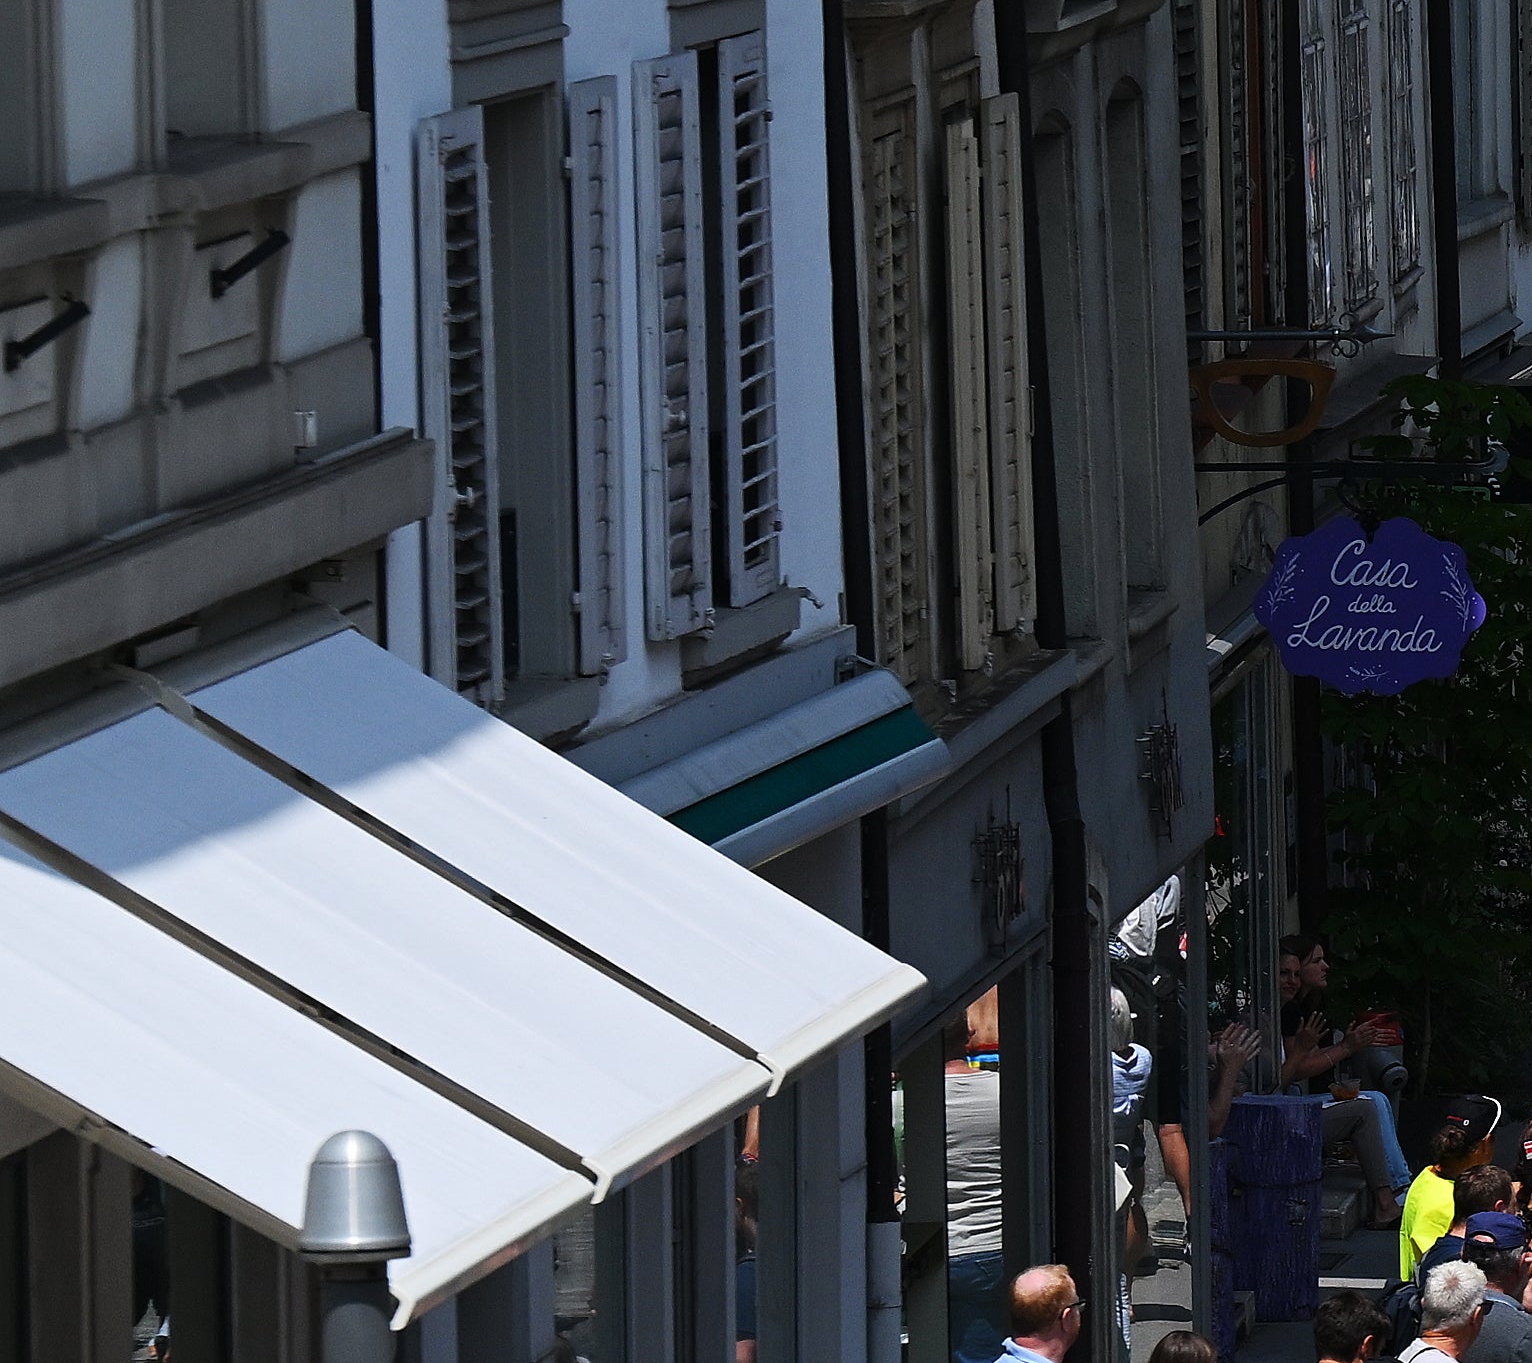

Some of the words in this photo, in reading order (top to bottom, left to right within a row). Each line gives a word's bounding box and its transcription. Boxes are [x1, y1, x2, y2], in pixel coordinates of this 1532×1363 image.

[1329, 539, 1418, 590] Casa
[1286, 596, 1442, 654] Lavanda
[1348, 595, 1397, 615] della
